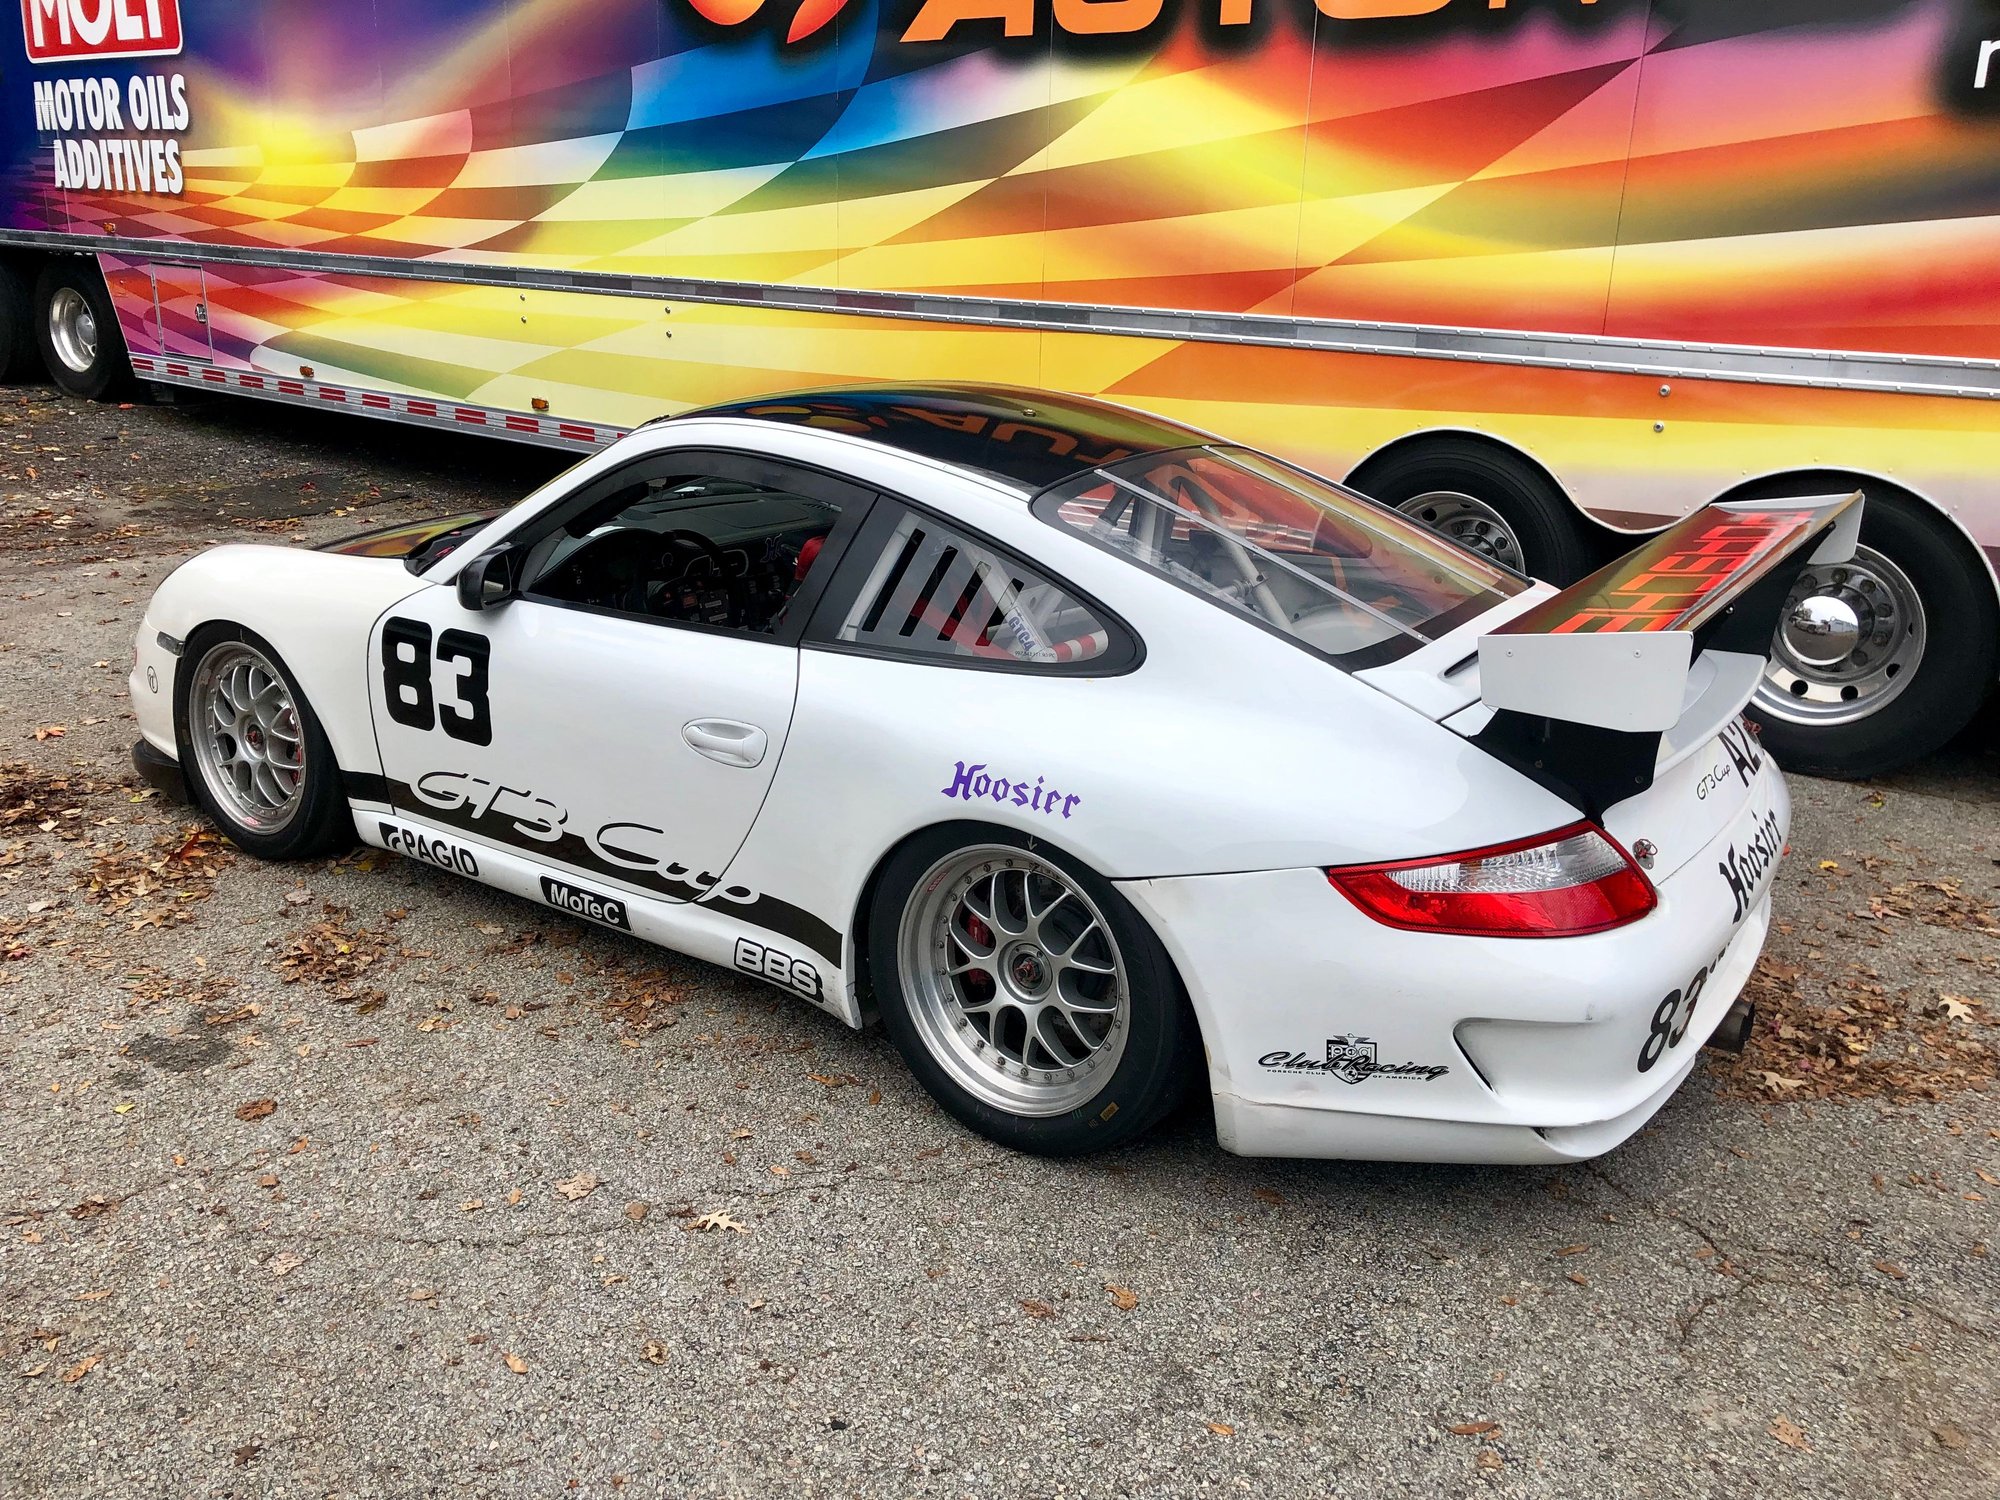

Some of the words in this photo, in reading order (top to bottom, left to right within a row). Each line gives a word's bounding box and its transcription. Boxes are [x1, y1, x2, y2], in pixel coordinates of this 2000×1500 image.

[33, 77, 125, 131] MOTOR
[128, 73, 189, 131] OILS
[54, 139, 183, 194] ADDITIVES
[1008, 616, 1036, 652] GTC4
[381, 616, 492, 747] 83
[941, 761, 1081, 819] Hoosier
[1696, 773, 1716, 800] GT3
[1713, 764, 1731, 782] Cup
[401, 827, 480, 878] PAGID
[409, 771, 569, 842] GT3
[584, 822, 761, 905] Cup
[1719, 808, 1781, 925] Hoosier
[550, 883, 620, 935] MoTeC
[734, 937, 822, 1001] BBS
[1258, 1051, 1342, 1071] Club
[1341, 1055, 1450, 1081] Racing
